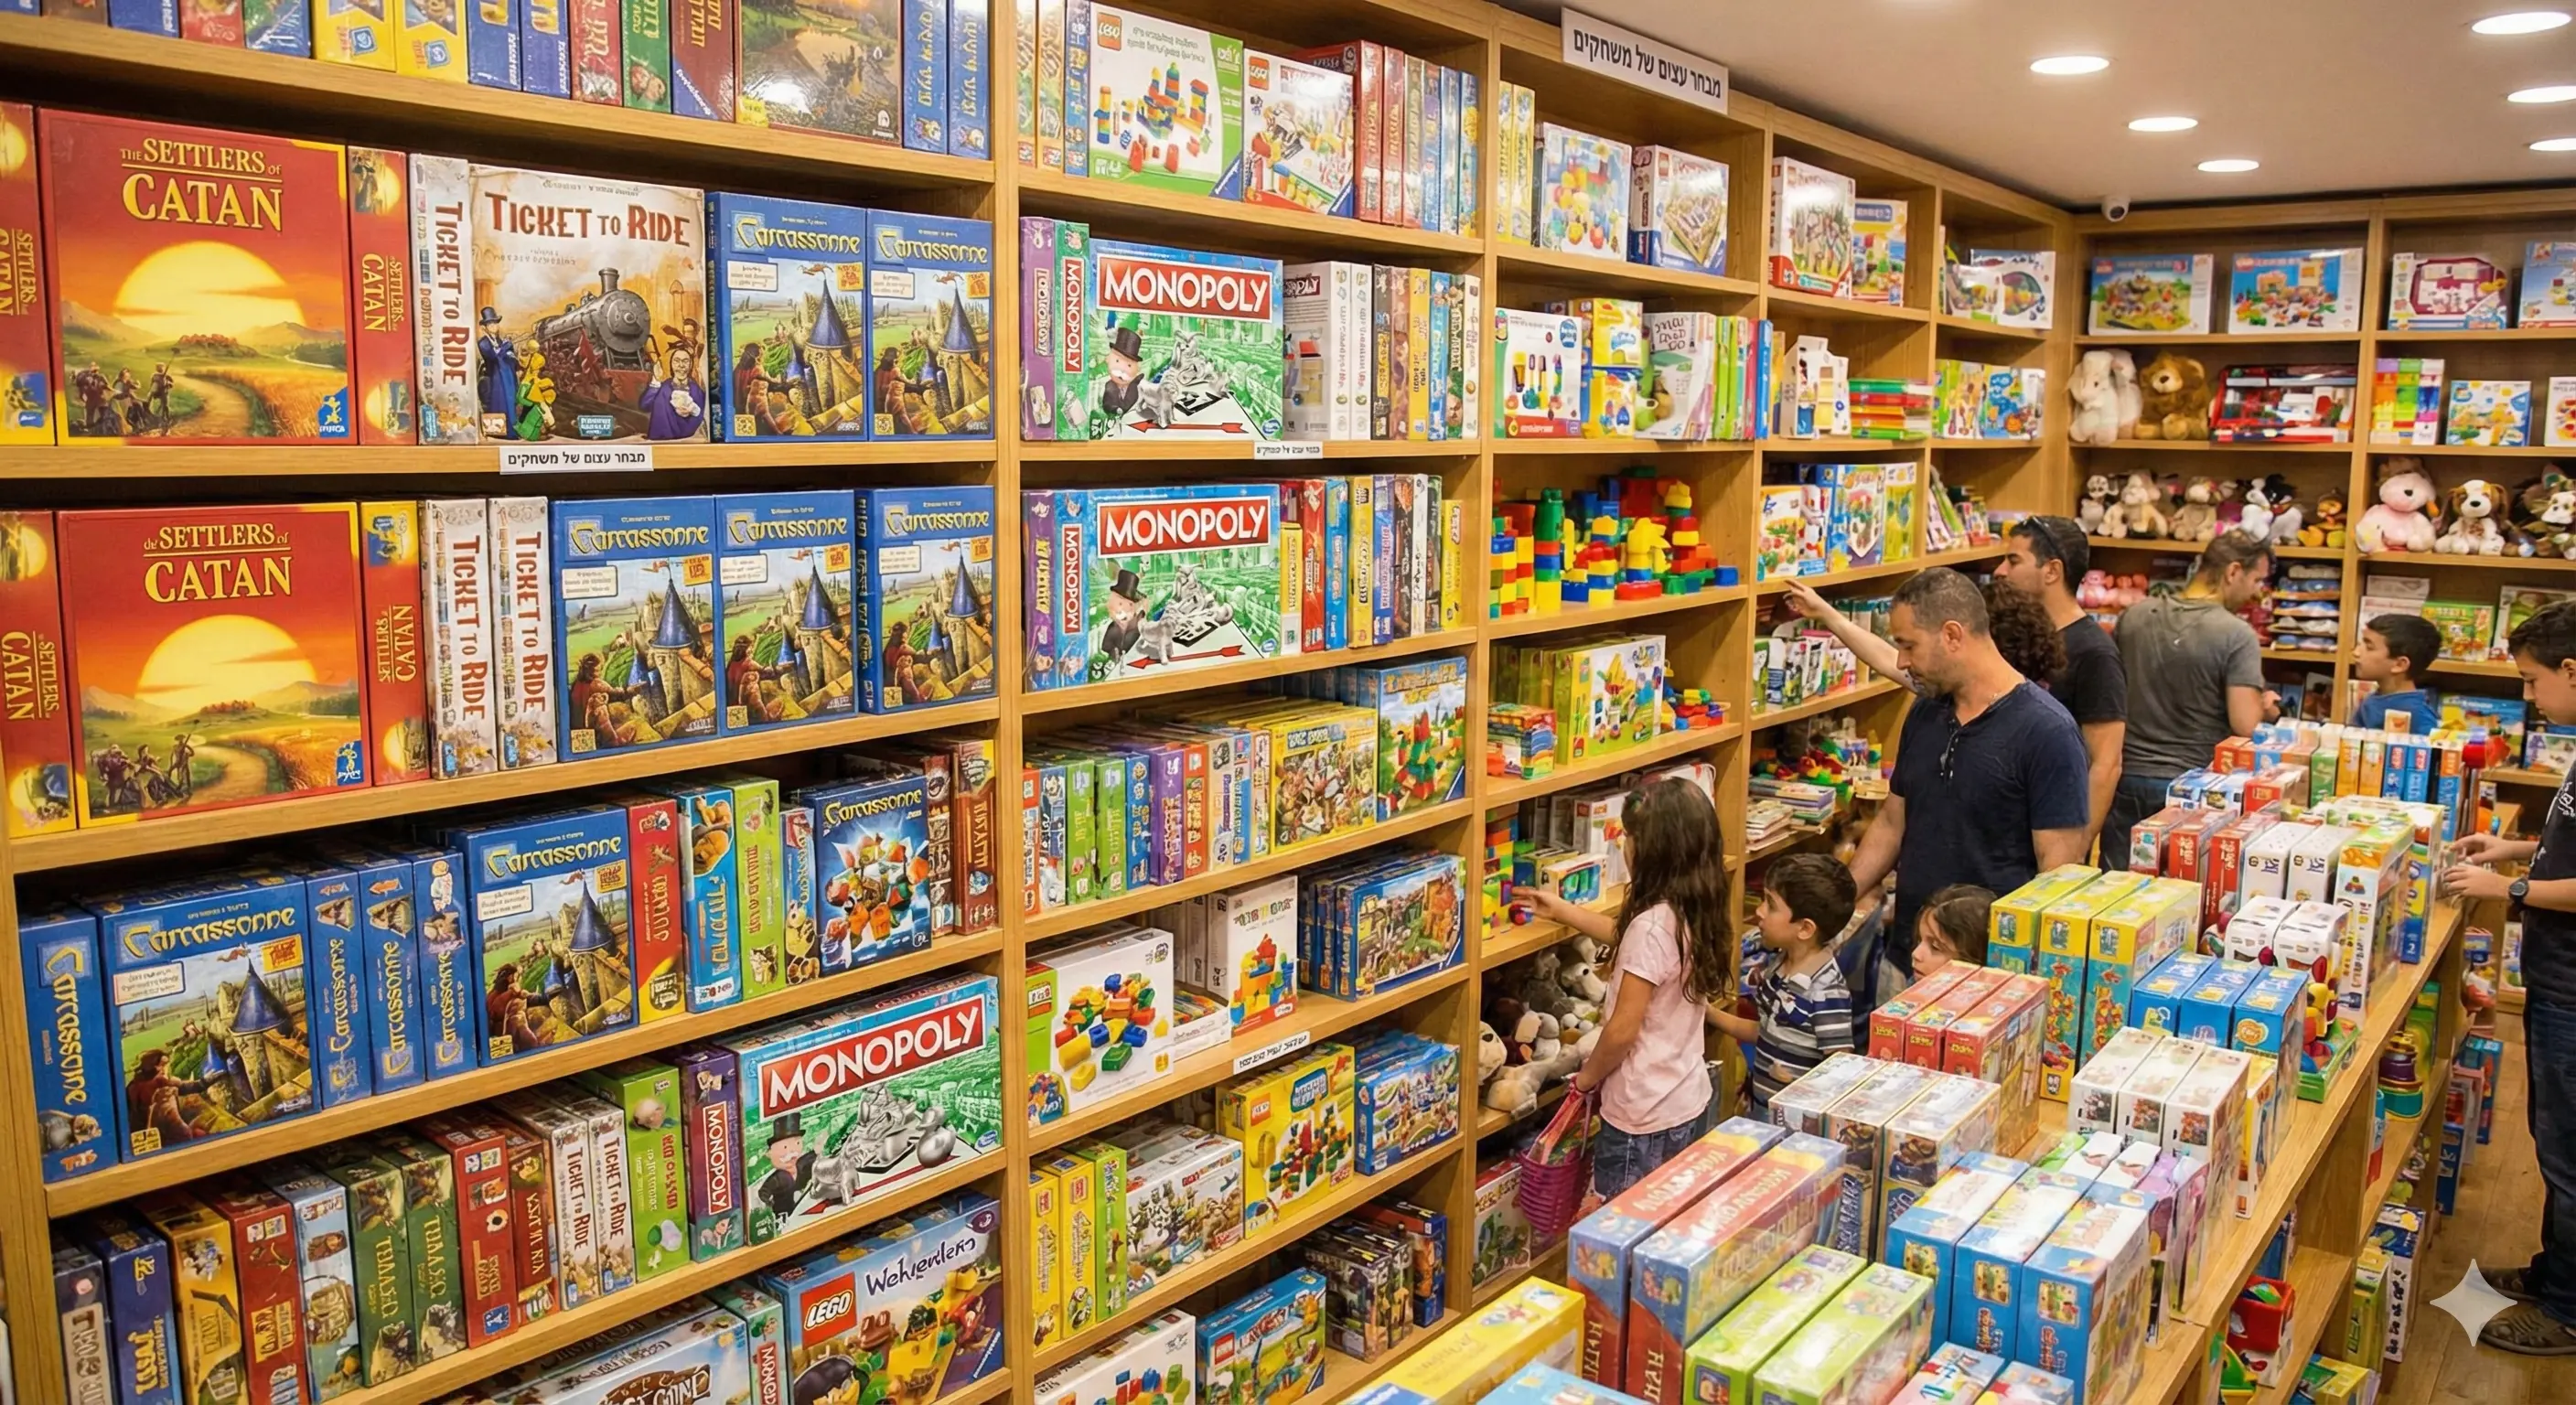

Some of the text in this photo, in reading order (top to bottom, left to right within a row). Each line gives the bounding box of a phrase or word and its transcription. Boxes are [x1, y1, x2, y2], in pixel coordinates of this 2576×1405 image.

[1573, 29, 1721, 99] מבחר עצום של משחקים
[144, 138, 265, 174] SETTLERS
[123, 173, 283, 231] CATAN
[485, 191, 690, 247] TICKET TO RIDE
[362, 253, 386, 333] CATAN
[435, 202, 470, 386] TICKET TO RIDE
[1066, 263, 1081, 369] MONOPOLY
[1104, 263, 1268, 313] MONOPOLY
[509, 451, 645, 467] מבחר עצום של משחקים
[159, 523, 274, 549] SETTLERS
[1105, 504, 1266, 548] MONOPOLY
[145, 556, 292, 603] CATAN
[393, 605, 416, 681] CATAN
[454, 535, 488, 721] TICKET TO RIDE
[516, 531, 548, 713] TICKET TO RIDE
[2, 631, 35, 720] CATAN
[769, 1006, 979, 1108] MONOPOLY
[708, 1109, 727, 1207] MONOPOLY
[574, 1213, 591, 1250] RIDE
[610, 1202, 627, 1239] RIDE
[806, 1292, 852, 1328] LEGO
